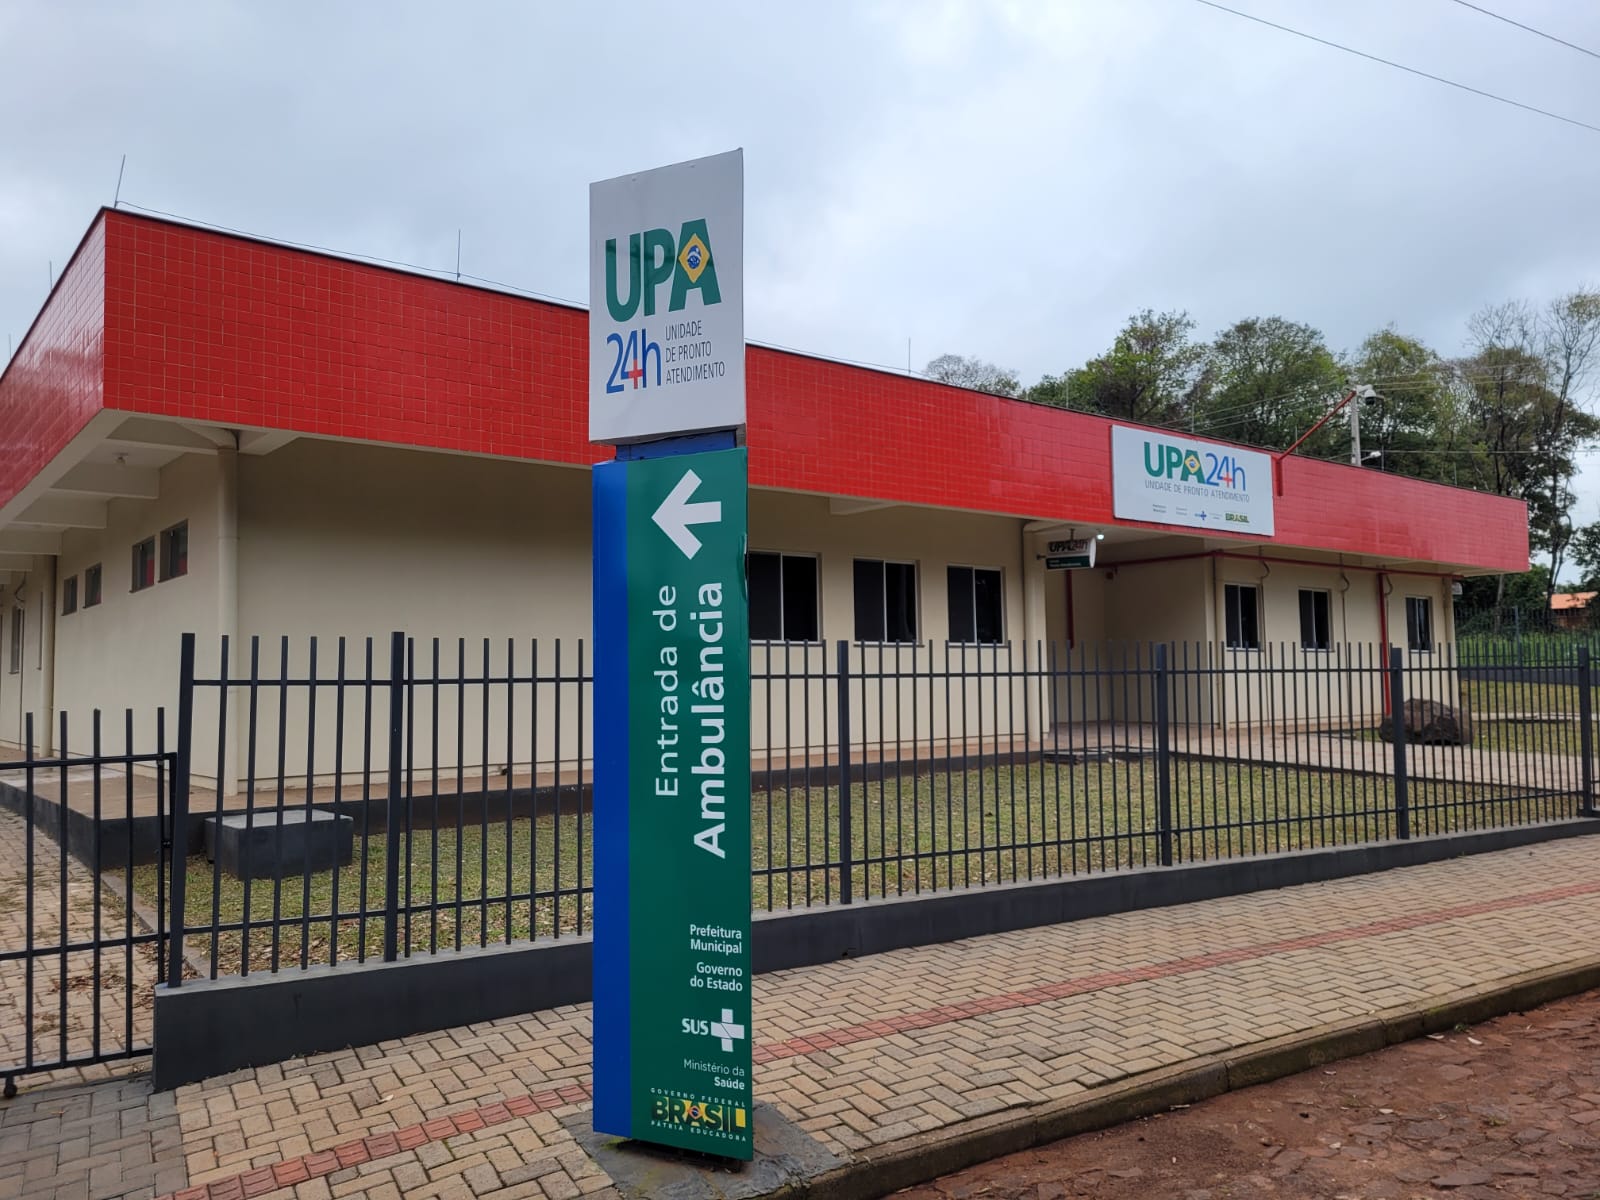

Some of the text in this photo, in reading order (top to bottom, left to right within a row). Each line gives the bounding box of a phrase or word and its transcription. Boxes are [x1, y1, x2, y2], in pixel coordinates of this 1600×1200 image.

[605, 218, 722, 323] UPA
[665, 320, 702, 341] UNIDADE
[606, 328, 662, 394] 24h
[665, 341, 712, 363] DE PRONTO
[666, 361, 726, 385] ATENDIMENTO
[1145, 479, 1250, 503] UNIDADE DE PRONTO ATENDIMENTO
[1225, 512, 1250, 523] BRASIL
[652, 585, 679, 796] Entrada de
[690, 582, 726, 859] Ambulância
[689, 923, 742, 940] Prefeitura
[690, 938, 742, 956] Municipal
[696, 961, 743, 977] Governo
[689, 975, 743, 992] do Estado
[681, 1018, 709, 1036] SUS
[683, 1058, 745, 1077] Ministério da
[714, 1076, 745, 1090] Saúde
[650, 1087, 746, 1108] GOVERNO FEDERAL
[652, 1096, 747, 1133] BRASIL
[690, 1127, 747, 1142] EDUCADORA
